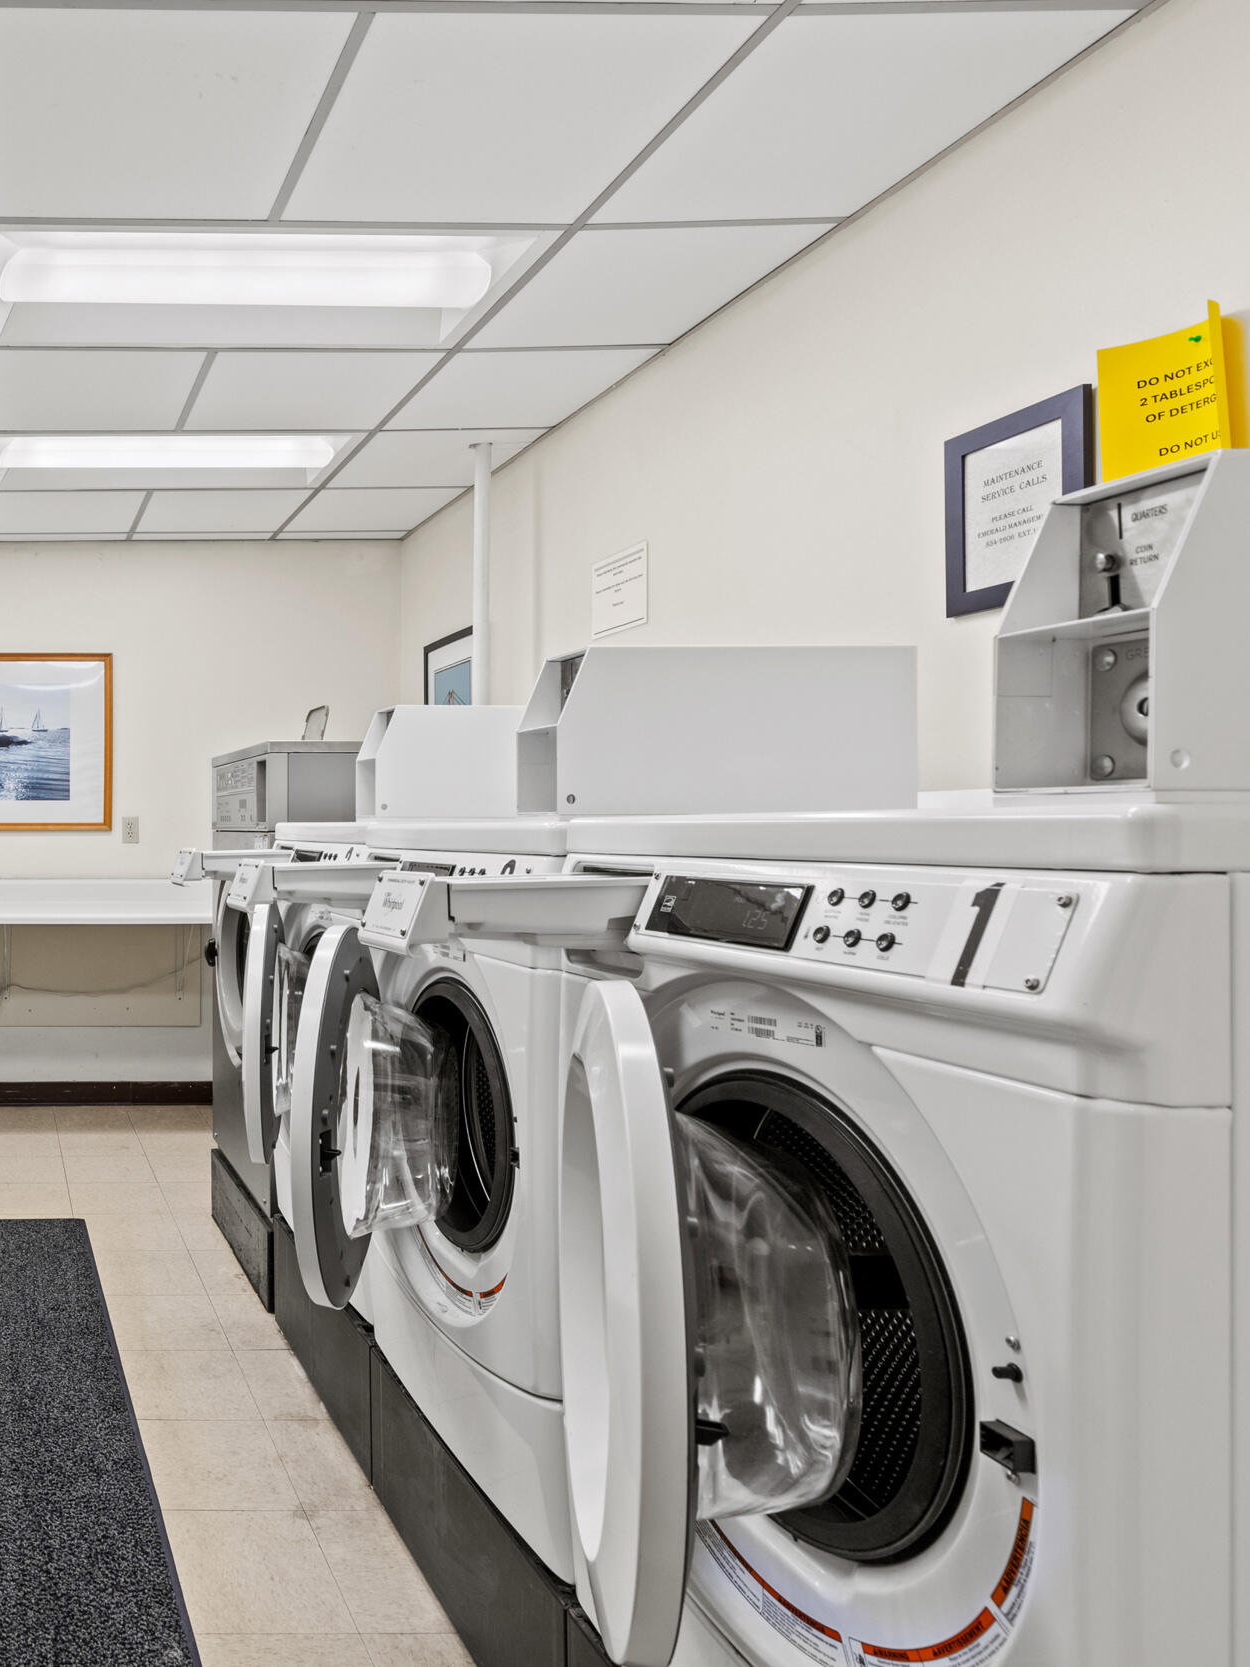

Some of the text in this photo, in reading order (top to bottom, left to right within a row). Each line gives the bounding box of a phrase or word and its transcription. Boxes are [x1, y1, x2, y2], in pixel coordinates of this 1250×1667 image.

[1137, 376, 1160, 389] DO
[1163, 366, 1193, 383] NOT
[1140, 397, 1148, 407] 2
[1145, 393, 1217, 423] OF DETERG
[1158, 443, 1181, 457] DO
[1184, 434, 1209, 450] NOT
[982, 459, 1044, 488] MAINTENANCE
[981, 473, 1048, 503] SERVICE CALLS
[991, 505, 1034, 523] PLEASE CALL
[1007, 514, 1044, 533] MANAGEM
[1131, 504, 1168, 523] QUARTERS
[1135, 543, 1154, 554] COIN
[1129, 553, 1160, 567] RETURN
[949, 882, 1006, 988] 1
